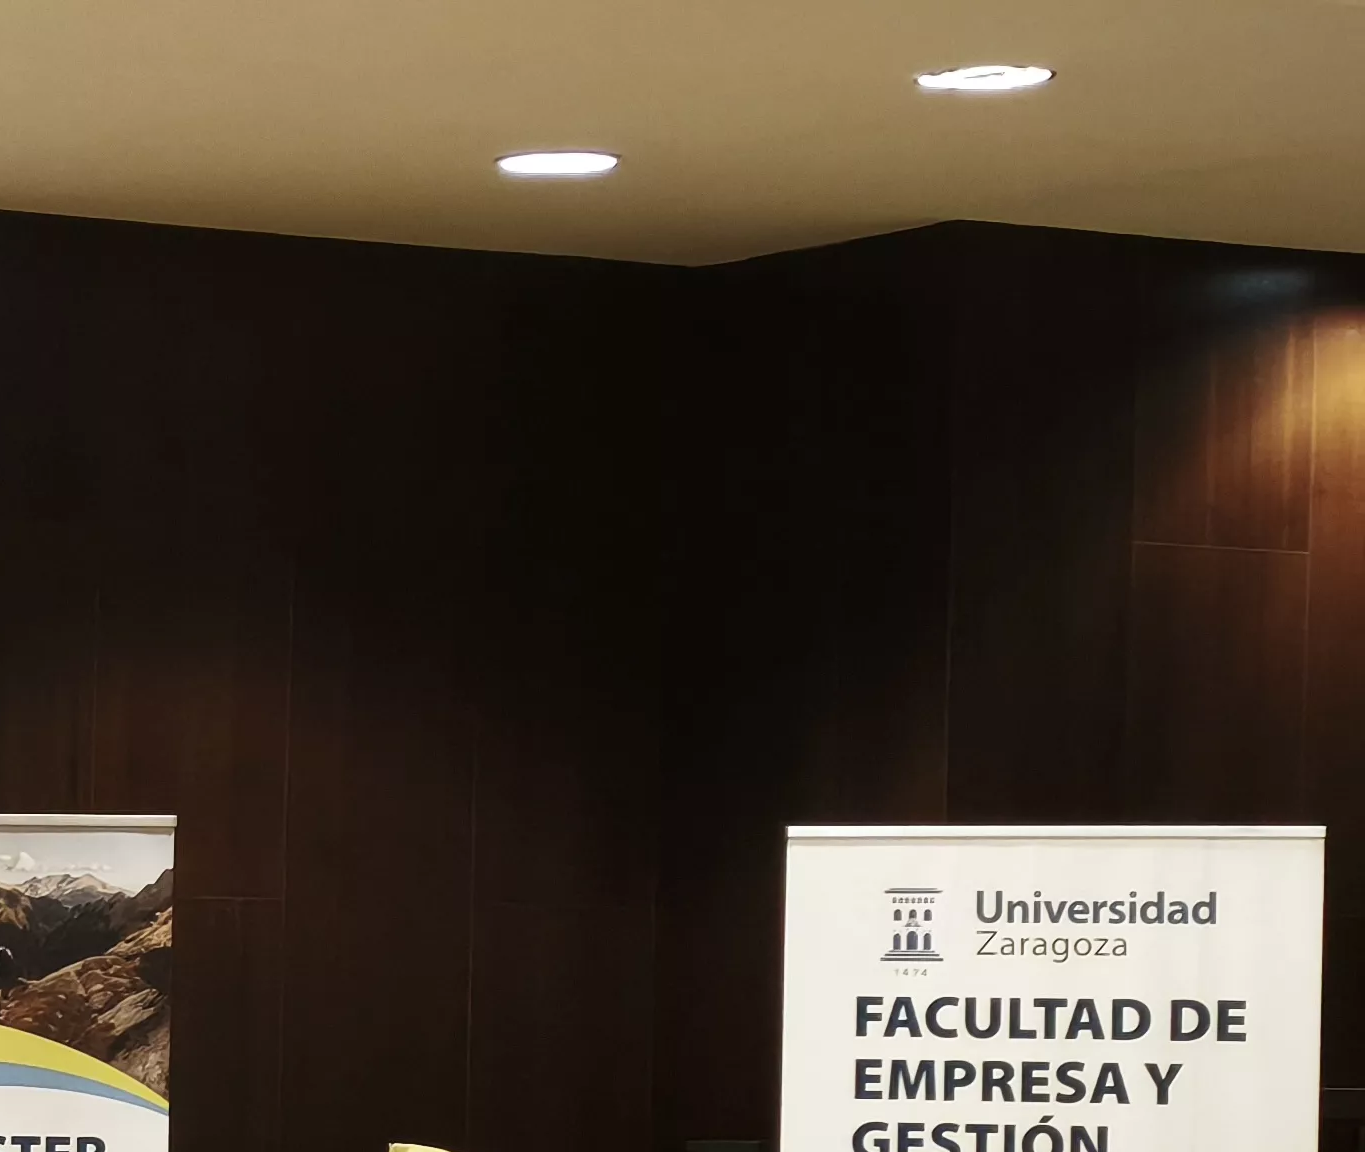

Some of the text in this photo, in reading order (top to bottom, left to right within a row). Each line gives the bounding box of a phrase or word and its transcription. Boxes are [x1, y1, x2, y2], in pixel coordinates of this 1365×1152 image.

[975, 890, 1217, 926] Universidad
[975, 930, 1129, 964] Zaragoza
[855, 996, 1248, 1042] FACULTAD DE
[854, 1059, 1183, 1105] EMPRESA Y
